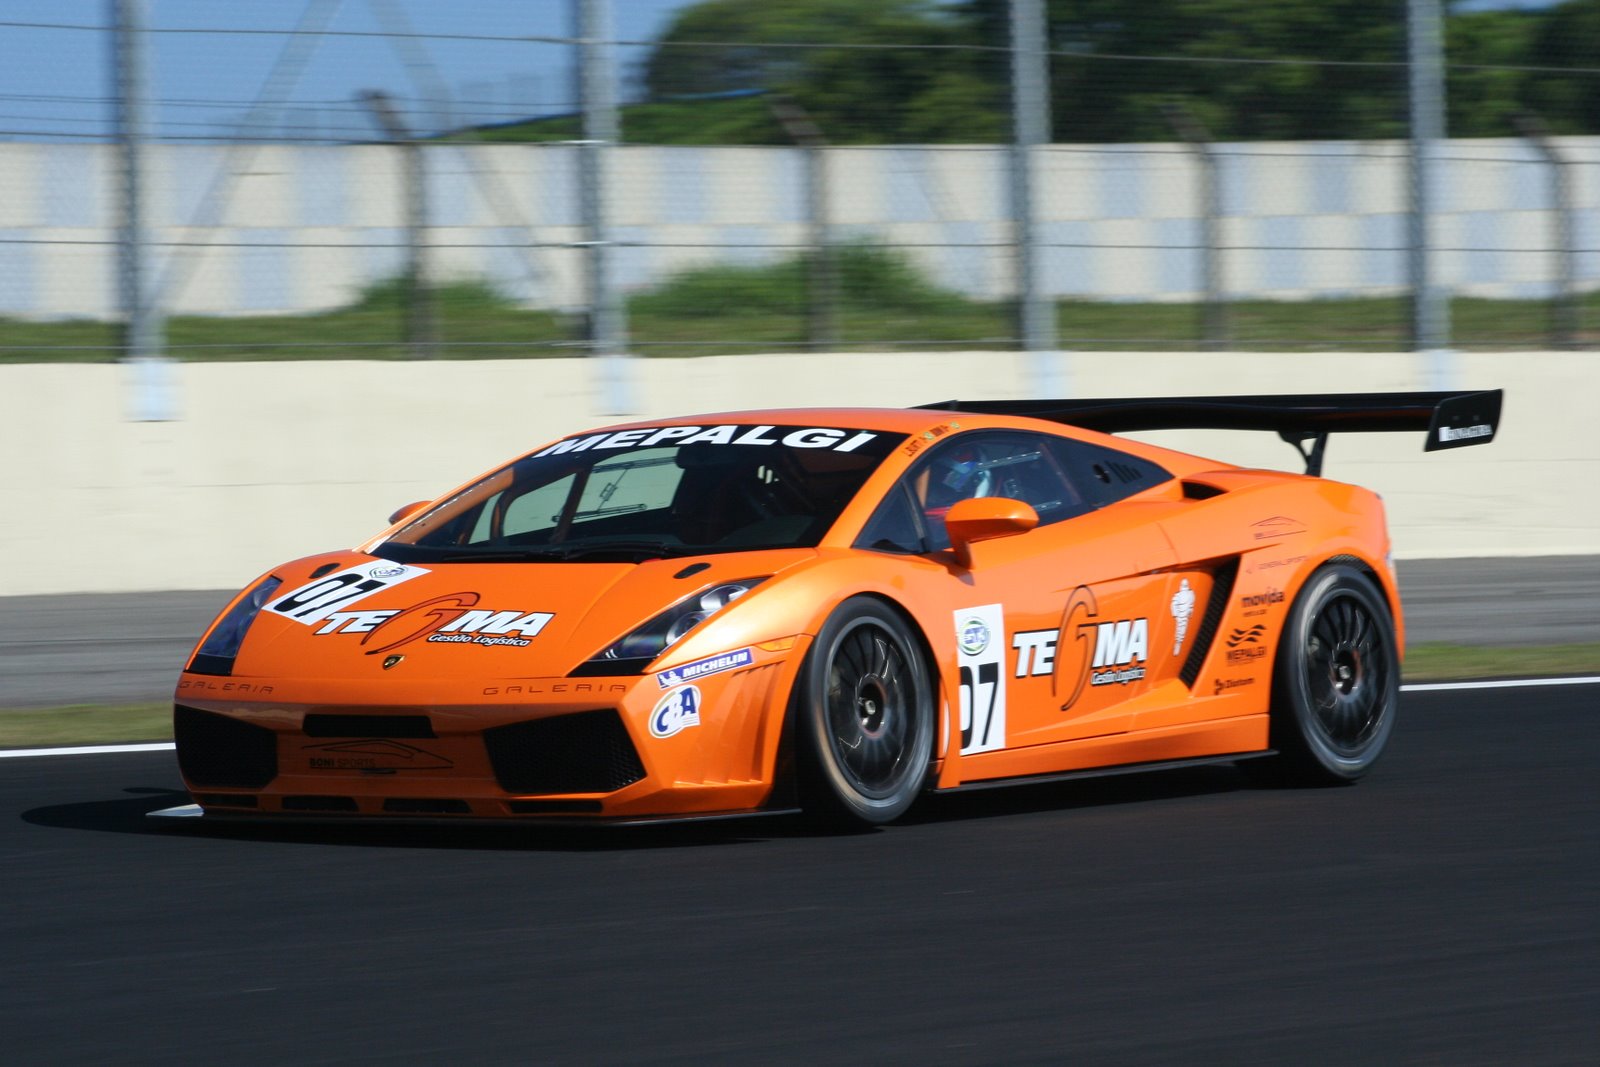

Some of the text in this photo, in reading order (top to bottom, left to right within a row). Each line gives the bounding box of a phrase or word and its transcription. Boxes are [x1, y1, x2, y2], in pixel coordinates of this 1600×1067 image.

[532, 425, 878, 458] MEPALGI
[273, 573, 387, 618] 07
[682, 651, 748, 678] MICHELIN
[482, 683, 627, 696] GALERIA
[309, 757, 335, 769] BONI
